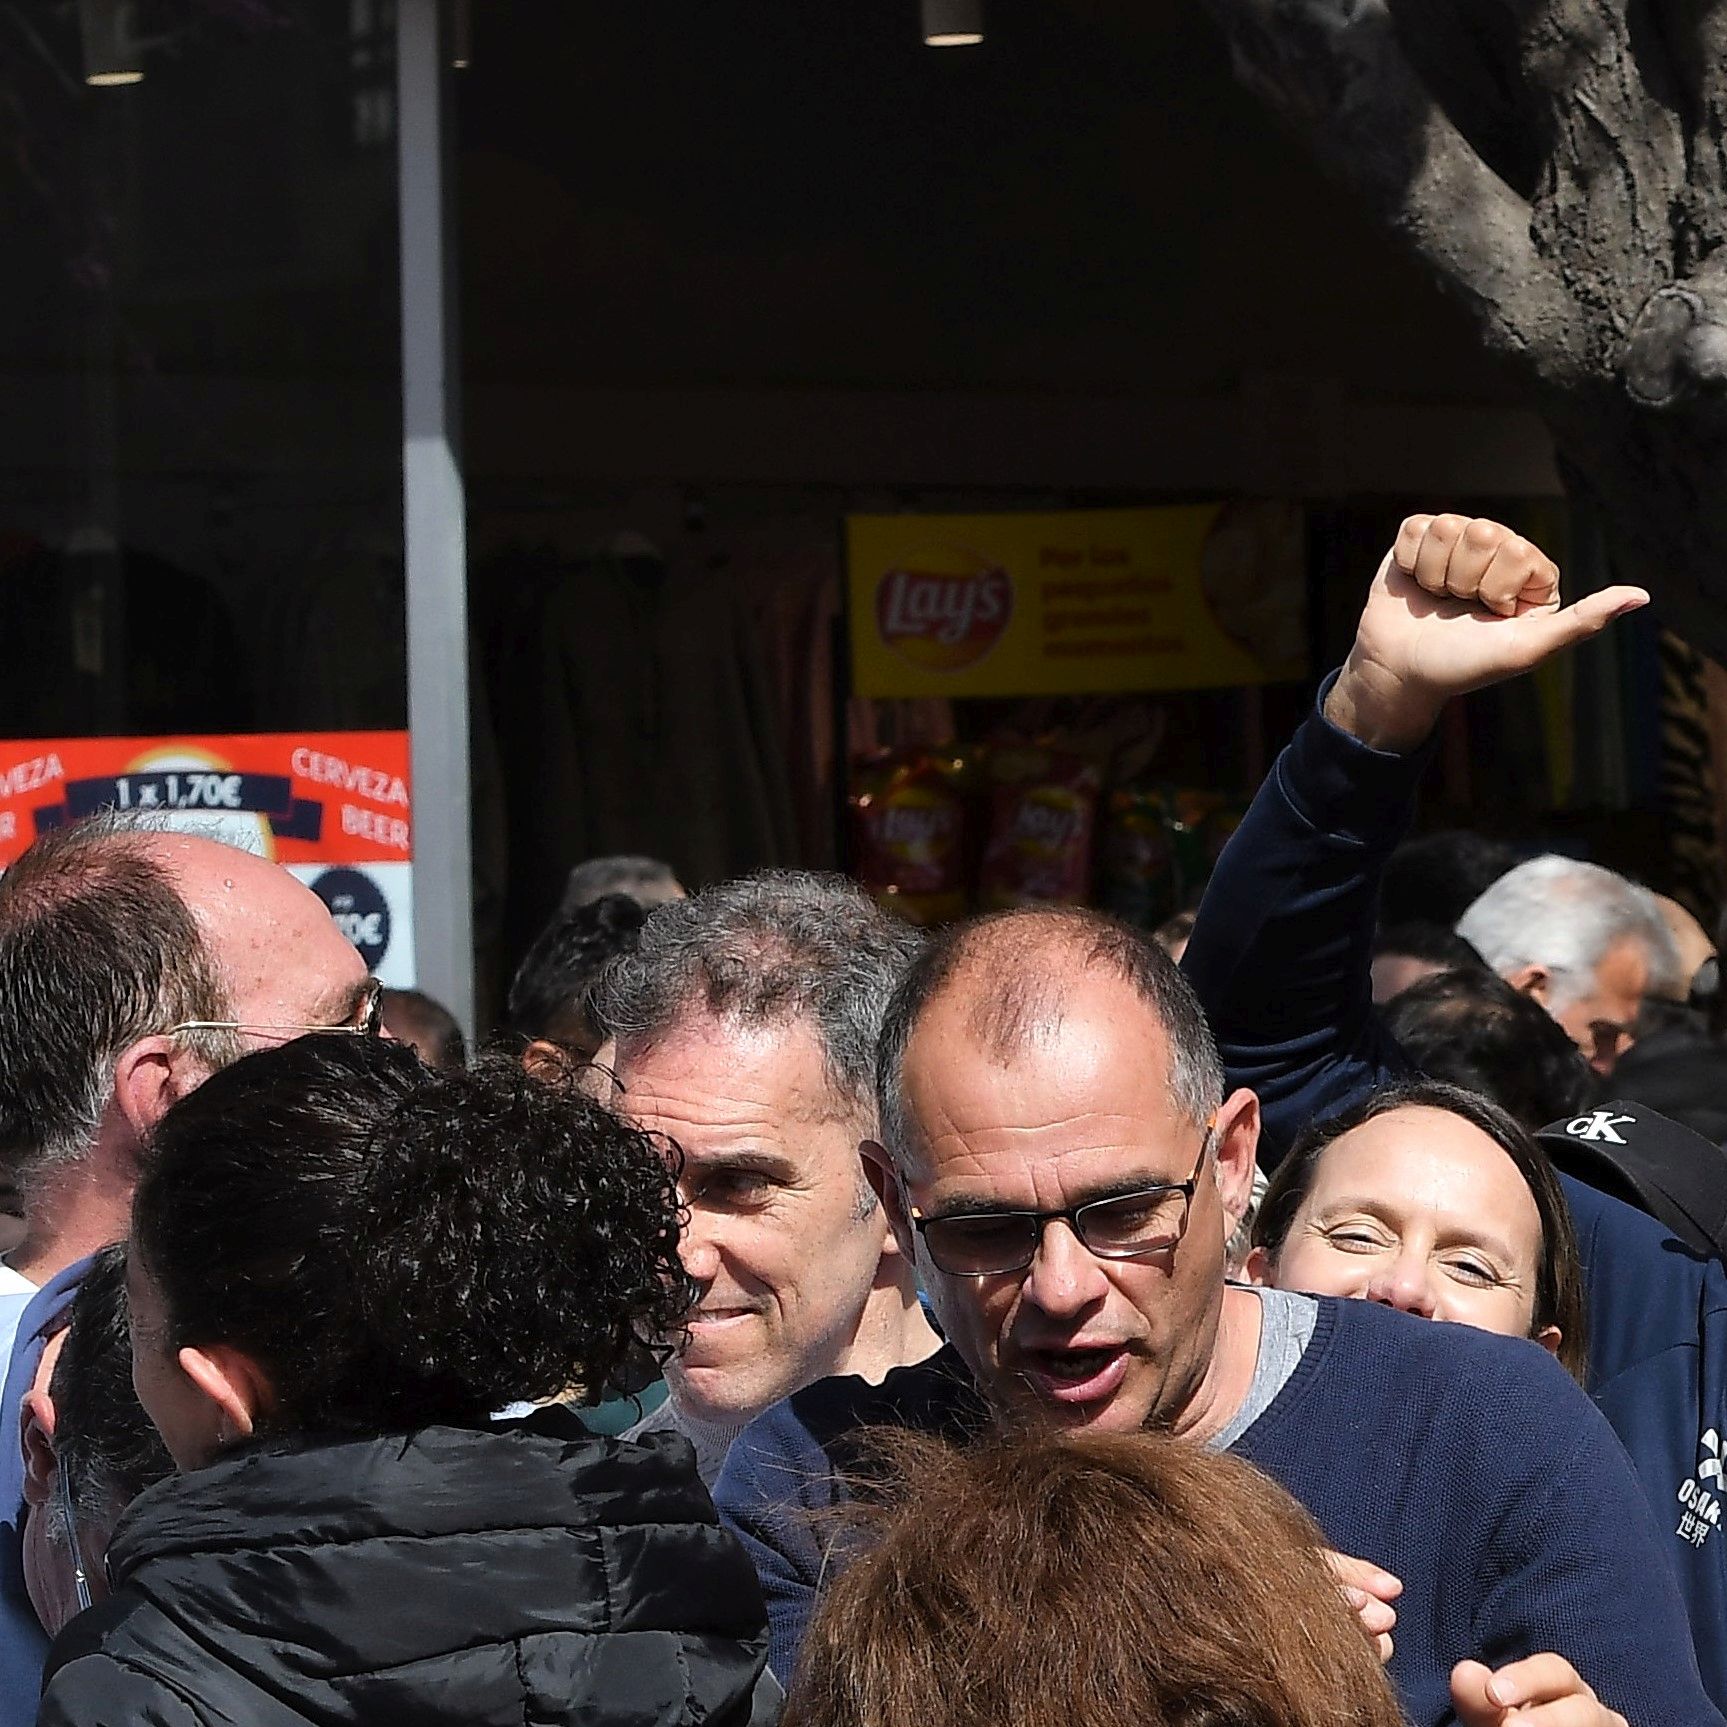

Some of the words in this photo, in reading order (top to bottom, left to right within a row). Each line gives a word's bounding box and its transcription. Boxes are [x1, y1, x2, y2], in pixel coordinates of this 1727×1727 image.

[885, 565, 1003, 644] Lay's
[116, 778, 131, 807] 1
[165, 775, 243, 808] 1,70€
[290, 747, 409, 804] CERVEZA
[340, 803, 410, 850] BEER
[1675, 1511, 1710, 1548] 世界
[1677, 1478, 1722, 1532] OSAK
